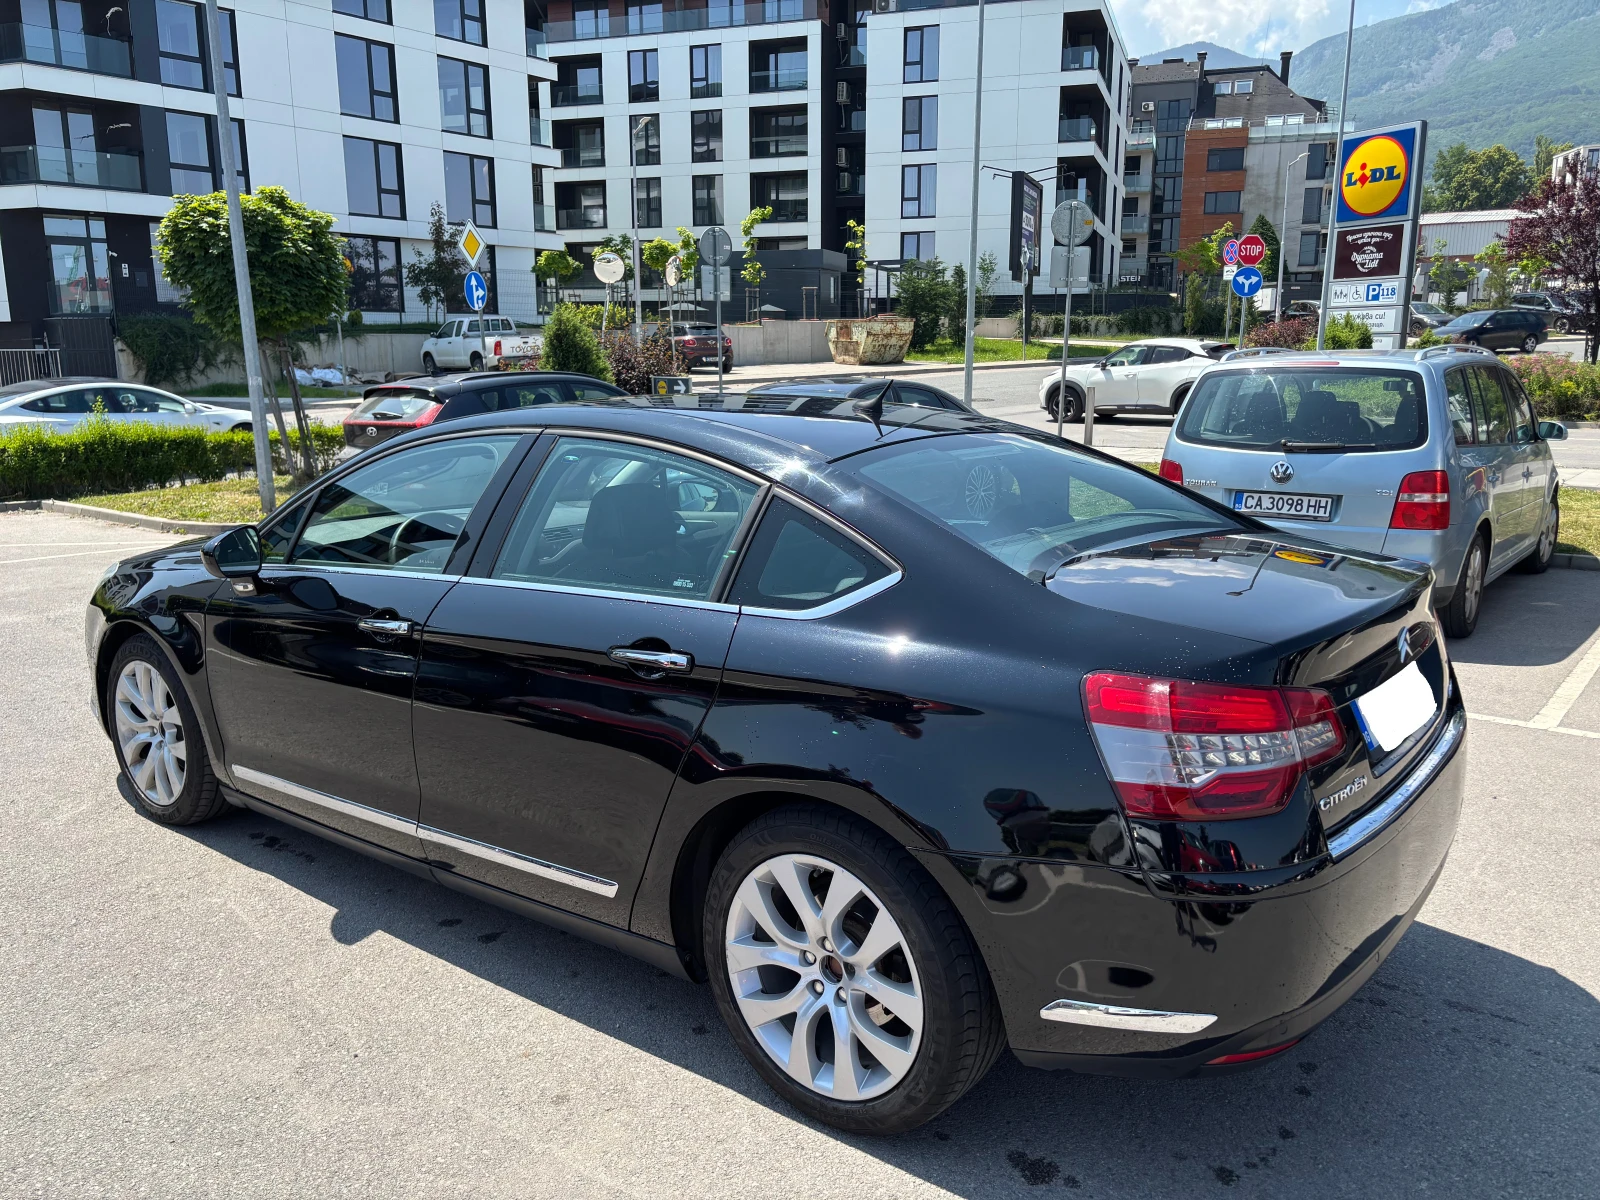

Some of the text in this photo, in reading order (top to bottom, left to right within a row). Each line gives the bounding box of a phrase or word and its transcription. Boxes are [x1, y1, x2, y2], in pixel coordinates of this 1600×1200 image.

[1240, 245, 1262, 256] STOP
[1380, 287, 1396, 297] 118
[1186, 478, 1217, 486] TOURAN
[1320, 775, 1368, 810] CITROËN
